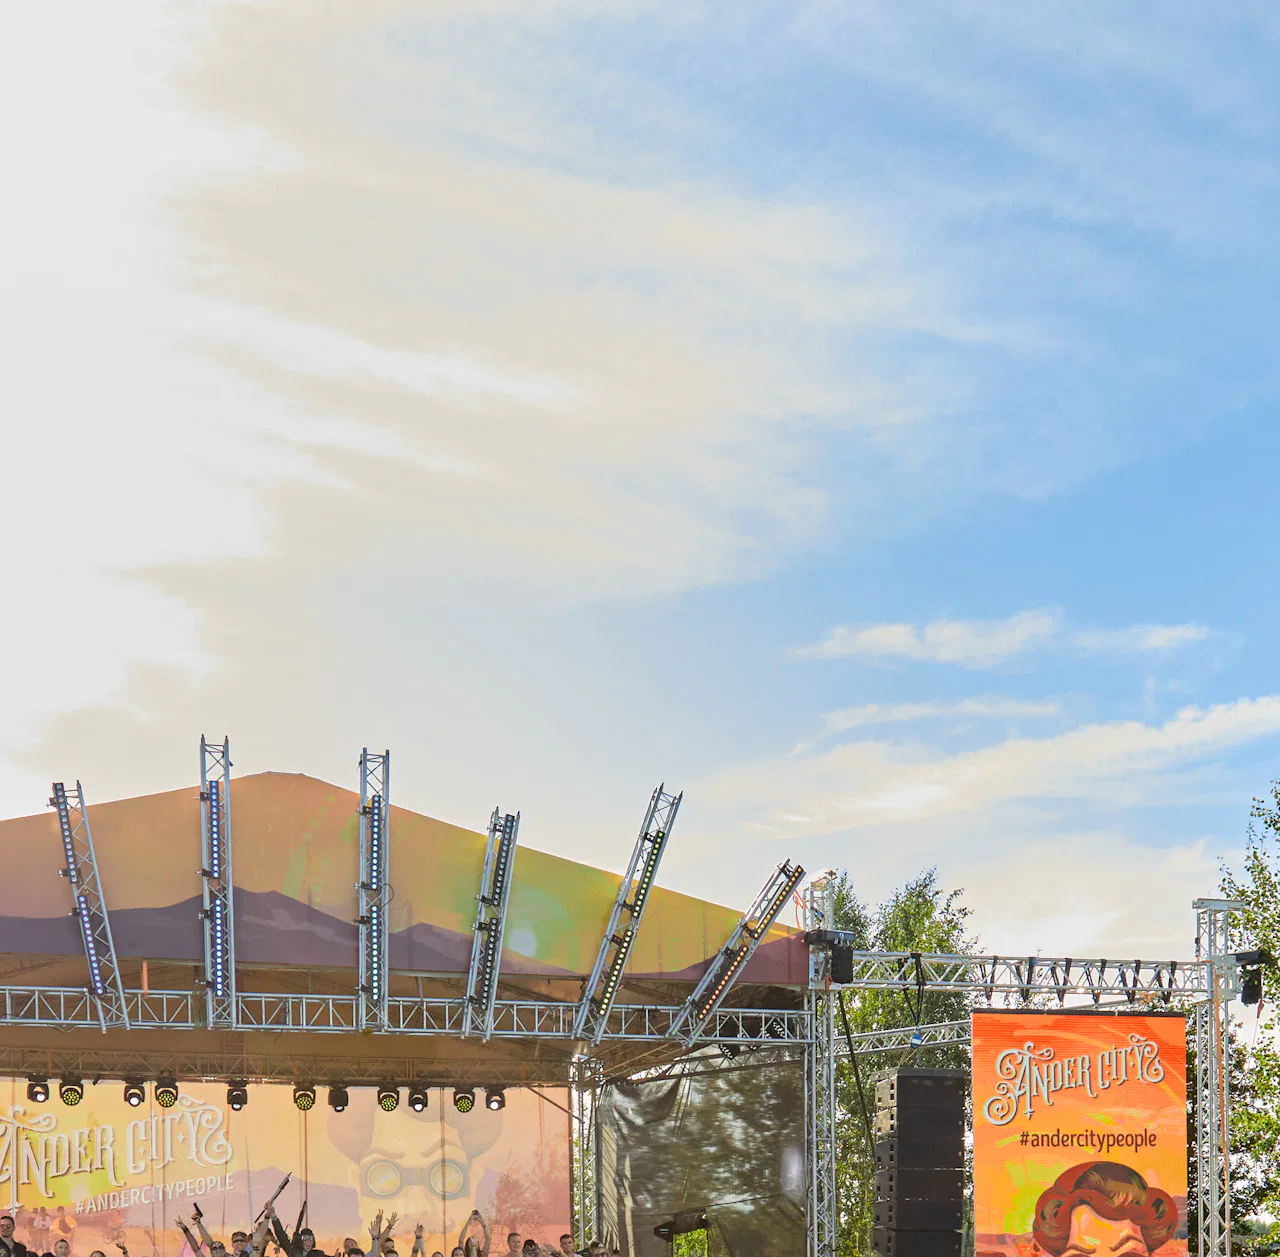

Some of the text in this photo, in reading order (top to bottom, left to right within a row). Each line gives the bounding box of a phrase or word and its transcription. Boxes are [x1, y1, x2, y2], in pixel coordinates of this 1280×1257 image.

[1098, 1033, 1165, 1084] CITY
[1020, 1128, 1157, 1153] #andercitypeople
[75, 1173, 234, 1215] #ANDERCITYPEOPLE
